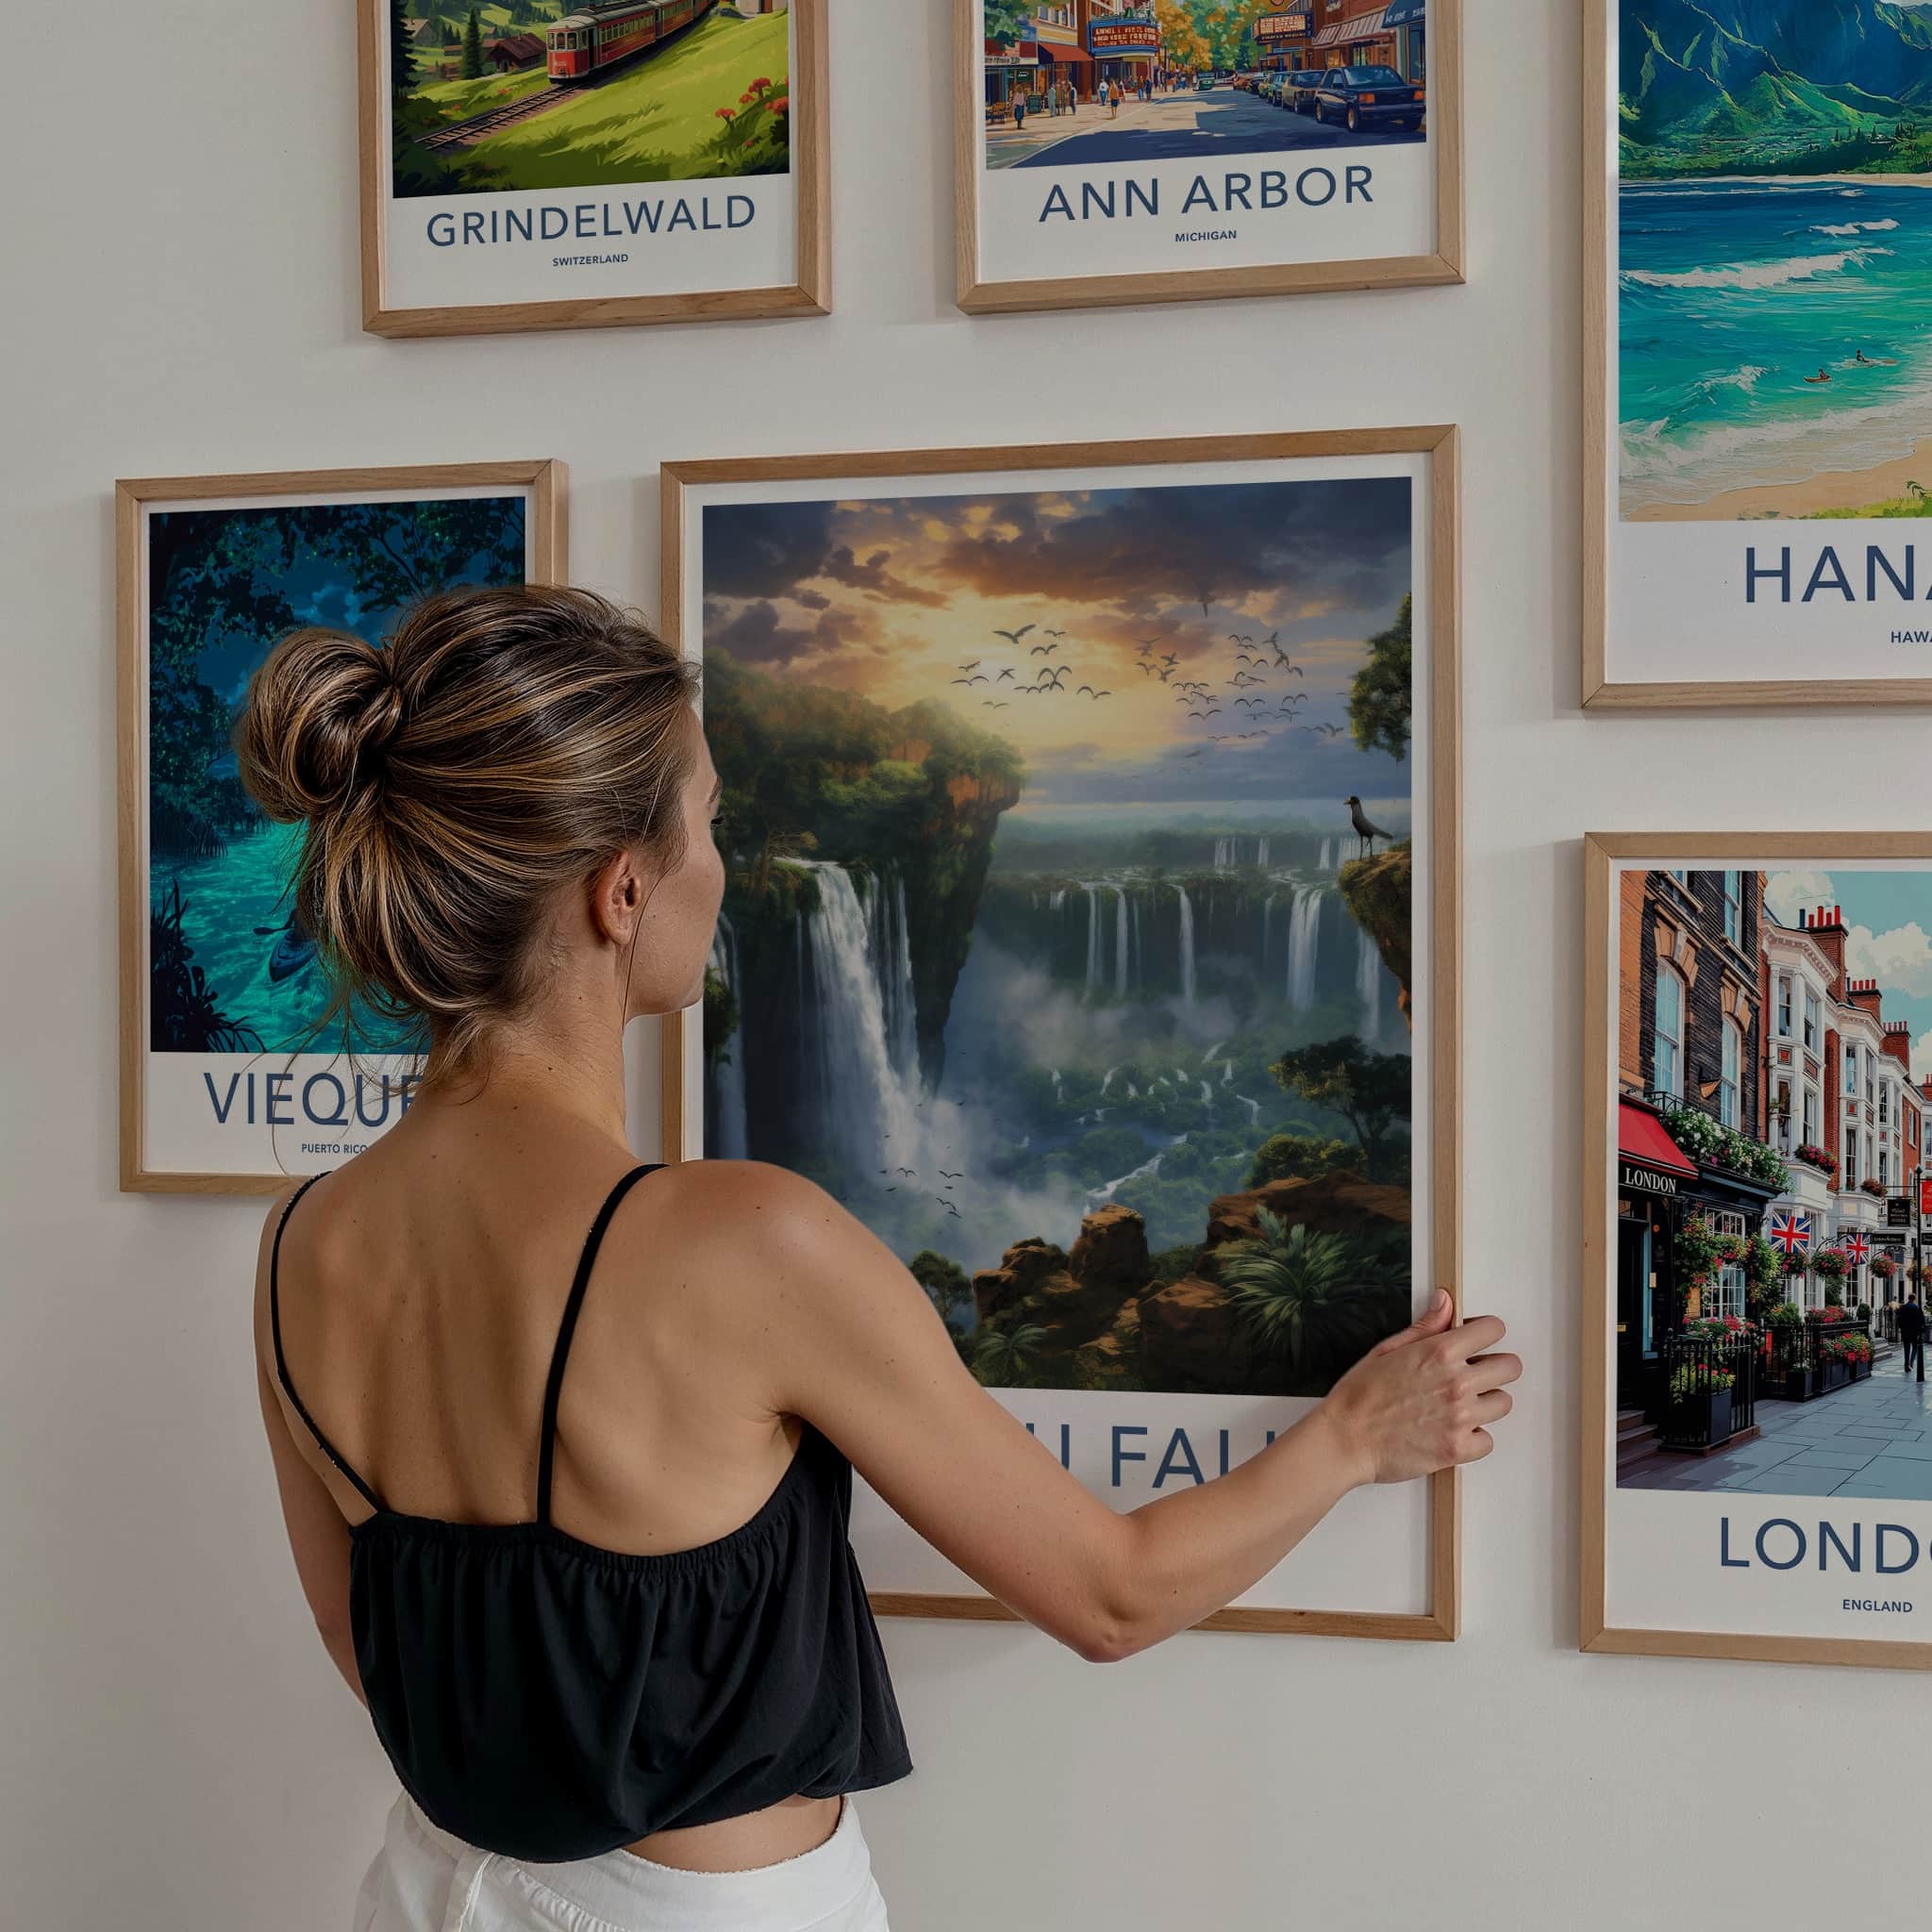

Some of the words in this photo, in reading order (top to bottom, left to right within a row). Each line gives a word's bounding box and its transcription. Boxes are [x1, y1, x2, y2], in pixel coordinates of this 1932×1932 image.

[1039, 177, 1159, 224] ANN
[1181, 164, 1374, 214] ARBOR
[425, 194, 757, 247] GRINDELWALD
[1174, 228, 1238, 243] MICHIGAN
[551, 253, 630, 268] SWITZERLAND
[1744, 544, 1932, 604] HAN
[1890, 629, 1932, 644] HAW
[300, 1142, 341, 1155] PUERTO
[1624, 1167, 1677, 1194] LONDON
[1720, 1515, 1932, 1574] LOND
[1841, 1598, 1914, 1614] ENGLAND
